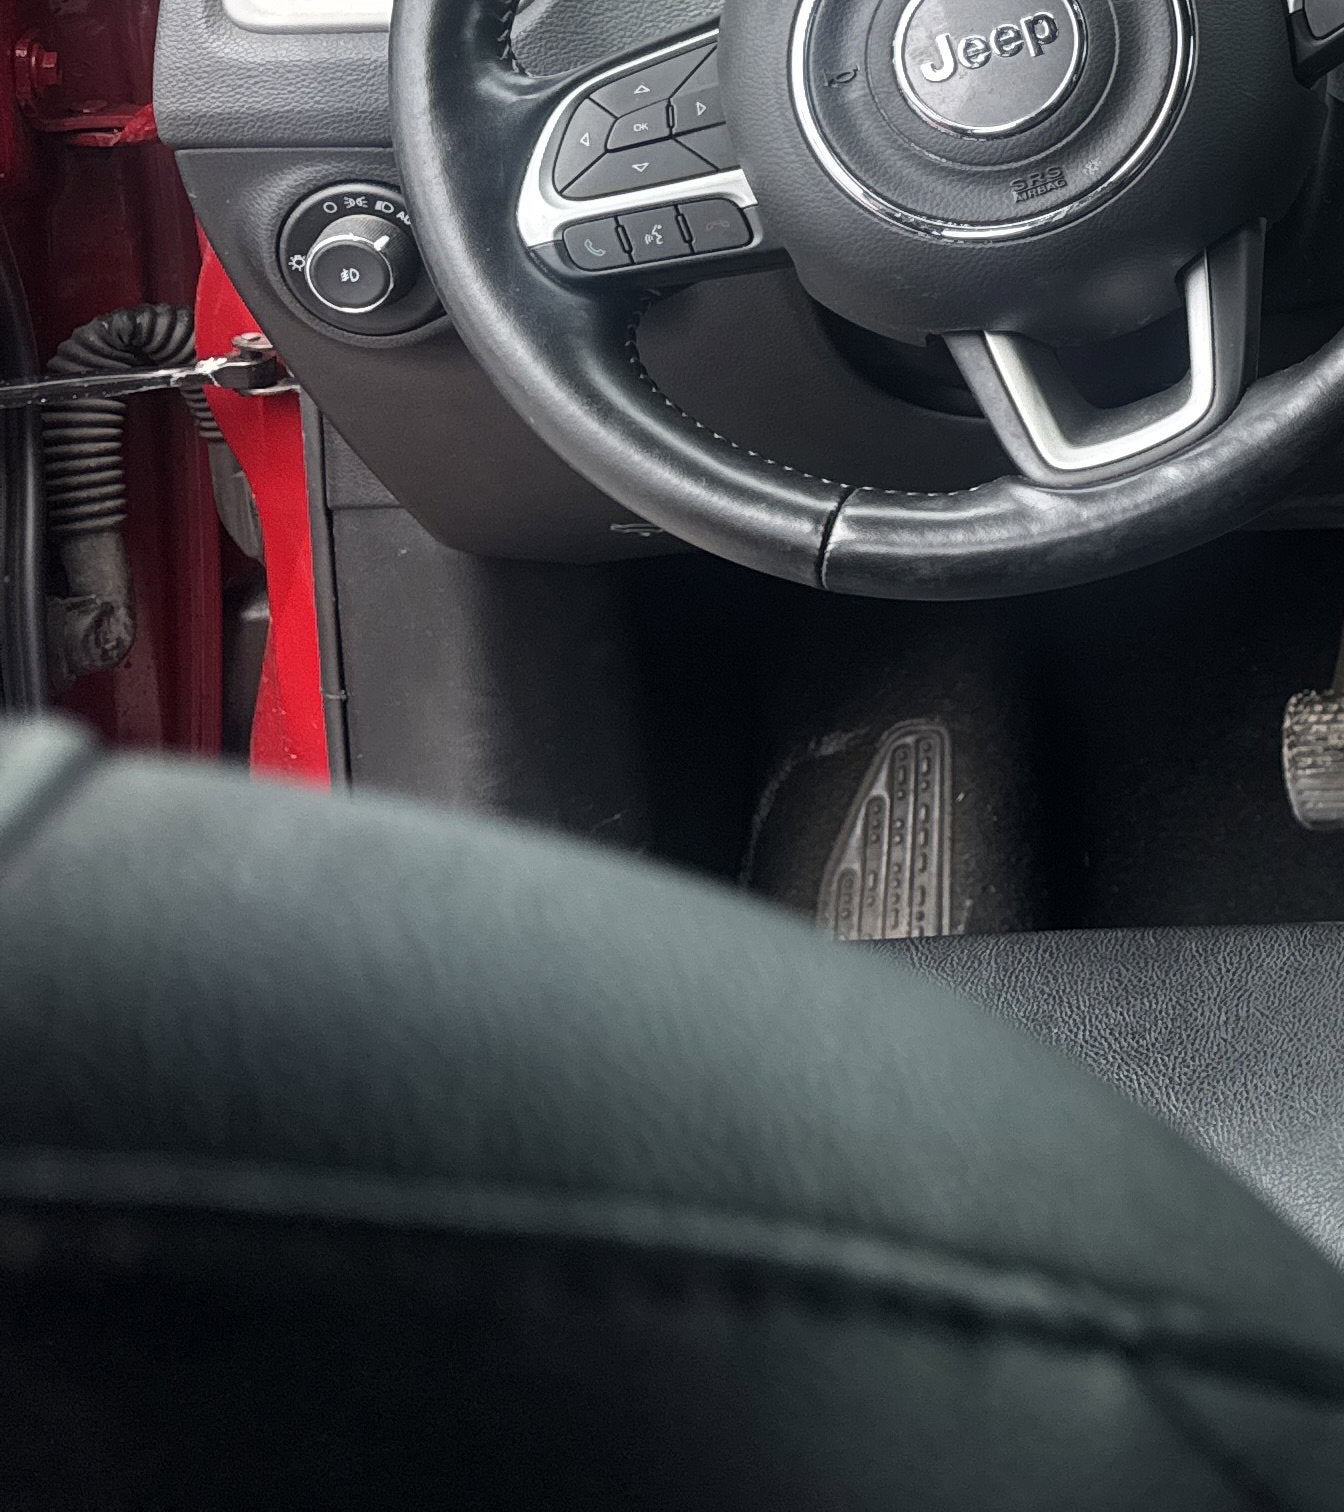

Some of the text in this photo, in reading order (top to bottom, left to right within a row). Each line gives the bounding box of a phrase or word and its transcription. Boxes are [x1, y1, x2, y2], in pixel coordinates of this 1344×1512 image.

[920, 10, 1060, 83] Jeep
[632, 121, 650, 133] OK
[1012, 177, 1068, 203] AIRBAG
